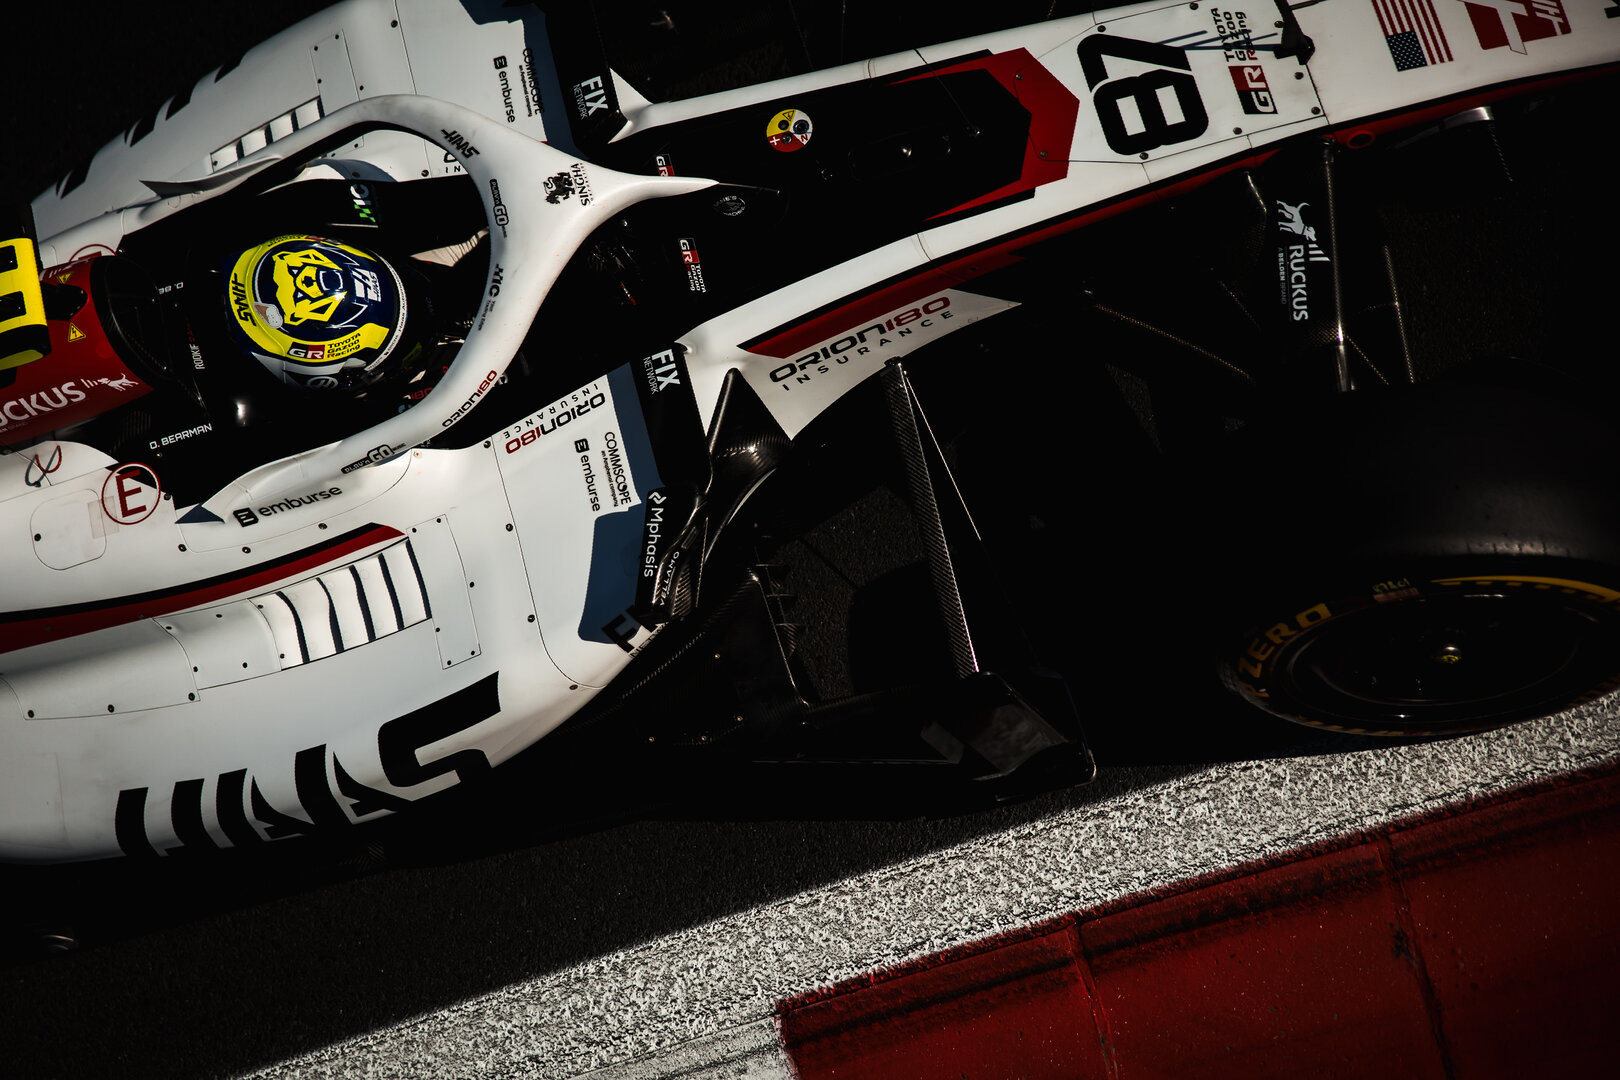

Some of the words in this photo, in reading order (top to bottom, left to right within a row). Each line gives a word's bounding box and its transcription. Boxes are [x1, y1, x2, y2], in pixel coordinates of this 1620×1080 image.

[1211, 8, 1230, 62] TOYOTA
[1223, 11, 1247, 61] GAZOO
[498, 71, 515, 123] emburse
[522, 48, 545, 115] COMMSCOPE
[572, 83, 589, 120] NETWORK
[580, 75, 609, 117] FIX
[1077, 34, 1209, 155] 87
[1242, 66, 1276, 114] GR
[571, 163, 591, 206] SINGHA
[493, 204, 509, 226] GO
[679, 239, 693, 264] GR
[1278, 252, 1286, 281] BELDEN
[684, 263, 696, 292] Racing
[690, 264, 701, 291] GAZOO
[695, 264, 707, 294] TOYOTA
[1289, 244, 1309, 322] RUCKUS
[288, 346, 325, 360] GR
[327, 339, 360, 354] GAZOO
[328, 332, 362, 348] TOYOTA
[769, 296, 951, 383] ORION180
[782, 310, 954, 391] INSURANCE
[642, 356, 659, 396] NETWORK
[650, 349, 681, 393] FIX
[442, 370, 498, 428] ORION180
[503, 383, 600, 439] INSURANCE
[505, 392, 606, 454] ORION180
[161, 423, 213, 447] BEARMAN
[367, 444, 394, 465] GO
[580, 455, 601, 512] emburse
[604, 431, 632, 505] COMMSCOPE
[115, 469, 148, 518] E
[258, 486, 343, 517] emburse
[643, 507, 665, 578] Mphasis
[659, 551, 680, 607] VELLAMO
[1237, 602, 1333, 679] ZERO
